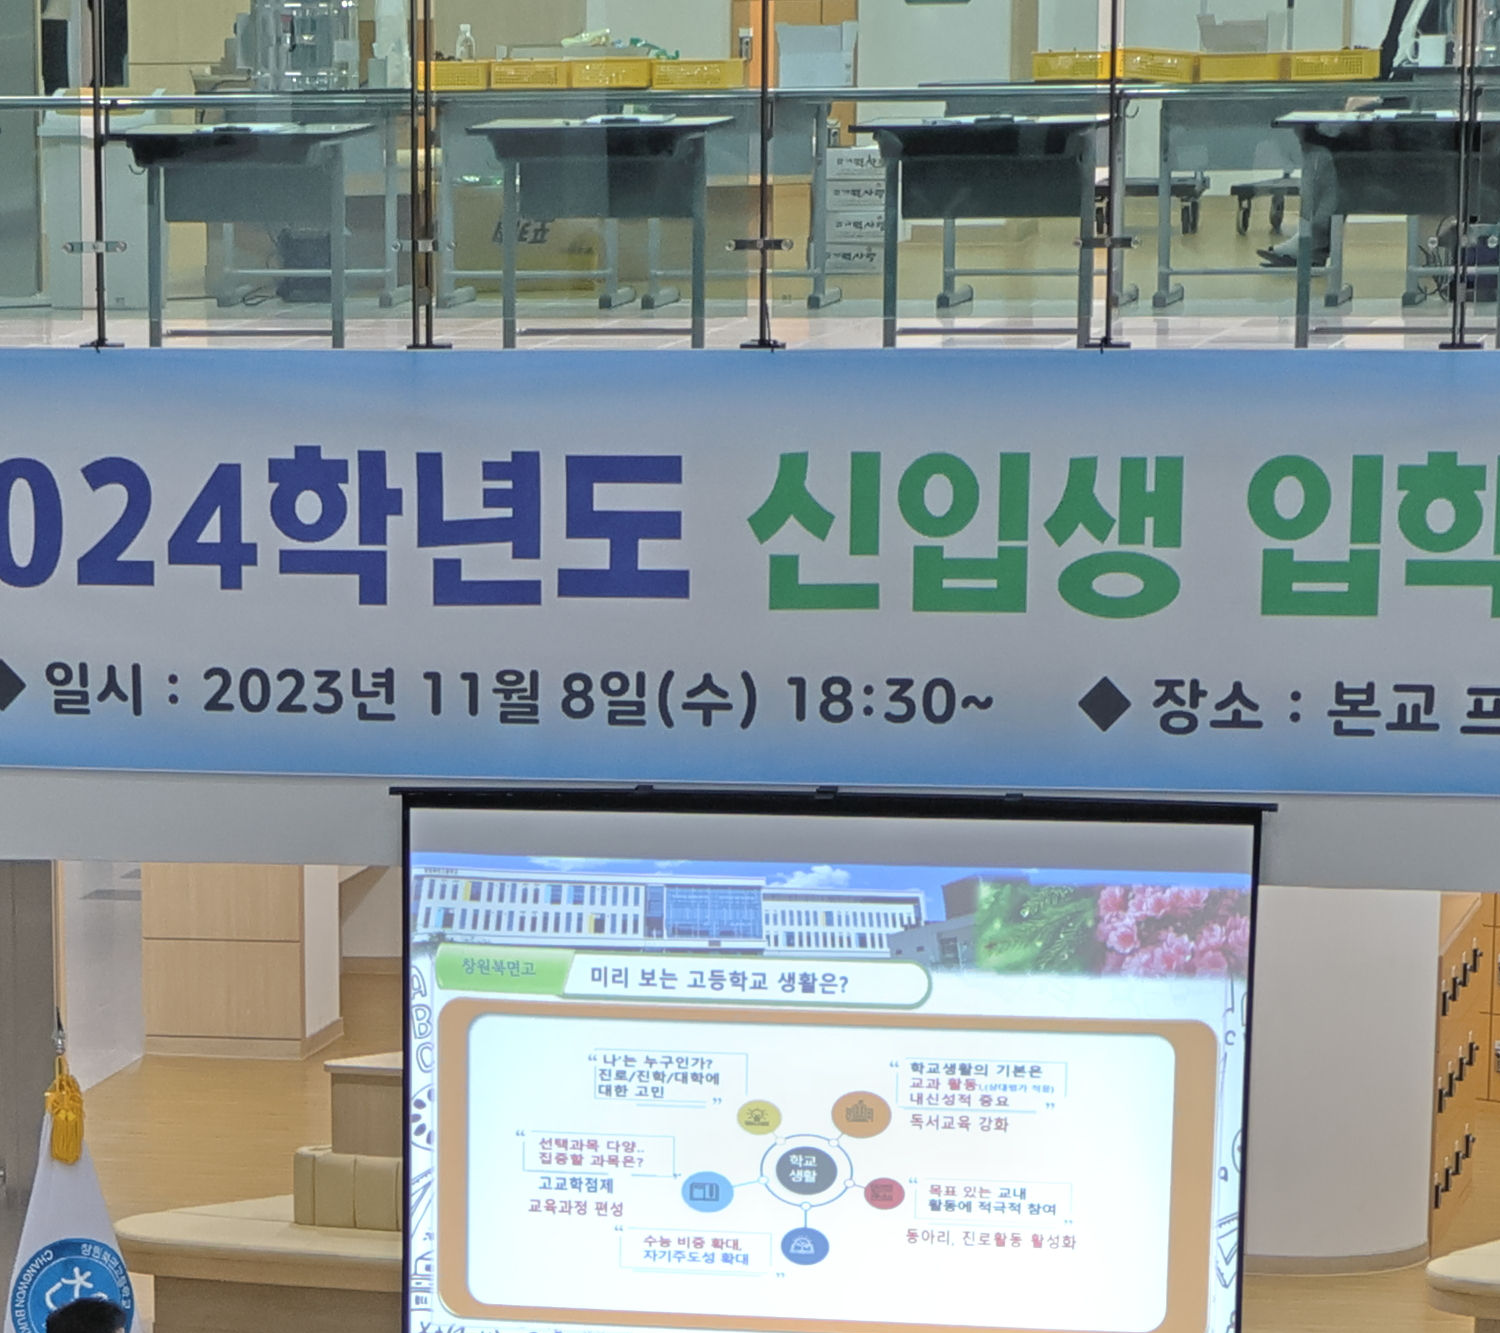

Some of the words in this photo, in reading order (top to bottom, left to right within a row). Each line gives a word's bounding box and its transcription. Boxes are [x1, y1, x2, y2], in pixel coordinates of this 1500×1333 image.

[746, 450, 1184, 619] 신입생
[44, 660, 143, 717] 일시
[202, 666, 397, 721] 2023년
[424, 670, 541, 725] 11월
[560, 668, 758, 730] 8일(수)
[786, 676, 995, 725] 18:30~
[1151, 676, 1265, 735] 장소
[1326, 680, 1441, 737] 본교
[462, 958, 536, 977] 창원북면고
[591, 966, 629, 988] 미리
[639, 967, 678, 990] 보는
[686, 969, 769, 992] 고등학교
[777, 971, 849, 994] 생활은?
[644, 1055, 713, 1071] 누구인가?
[910, 1061, 989, 1077] 학교생활의
[996, 1063, 1043, 1078] 기본은
[598, 1068, 720, 1086] 진로/진학/대학에
[909, 1077, 940, 1091] 교과
[598, 1084, 628, 1097] 대한
[635, 1085, 665, 1099] 고민
[909, 1092, 972, 1107] 내신성적
[978, 1093, 1010, 1107] 중요
[909, 1113, 971, 1132] 독서교육
[978, 1115, 1009, 1133] 강화
[539, 1137, 600, 1151] 선택과목
[539, 1152, 584, 1166] 집중할
[590, 1154, 644, 1168] 과목은?
[789, 1154, 817, 1168] 학교
[789, 1168, 817, 1184] 생활
[538, 1176, 614, 1194] 고교학점제
[928, 1184, 957, 1197] 목표
[963, 1185, 992, 1199] 있는
[998, 1187, 1027, 1200] 교내
[528, 1198, 587, 1216] 교육과정
[595, 1201, 624, 1217] 편성
[928, 1199, 972, 1213] 활동에
[978, 1200, 1021, 1215] 적극적
[1027, 1202, 1056, 1216] 참여
[643, 1234, 672, 1248] 수능
[677, 1236, 706, 1250] 비중
[963, 1230, 1022, 1248] 진로활동
[1031, 1233, 1077, 1250] 활성화
[643, 1249, 715, 1264] 자기주도성
[721, 1252, 749, 1266] 확대
[14, 1249, 54, 1308] CHANGWON
